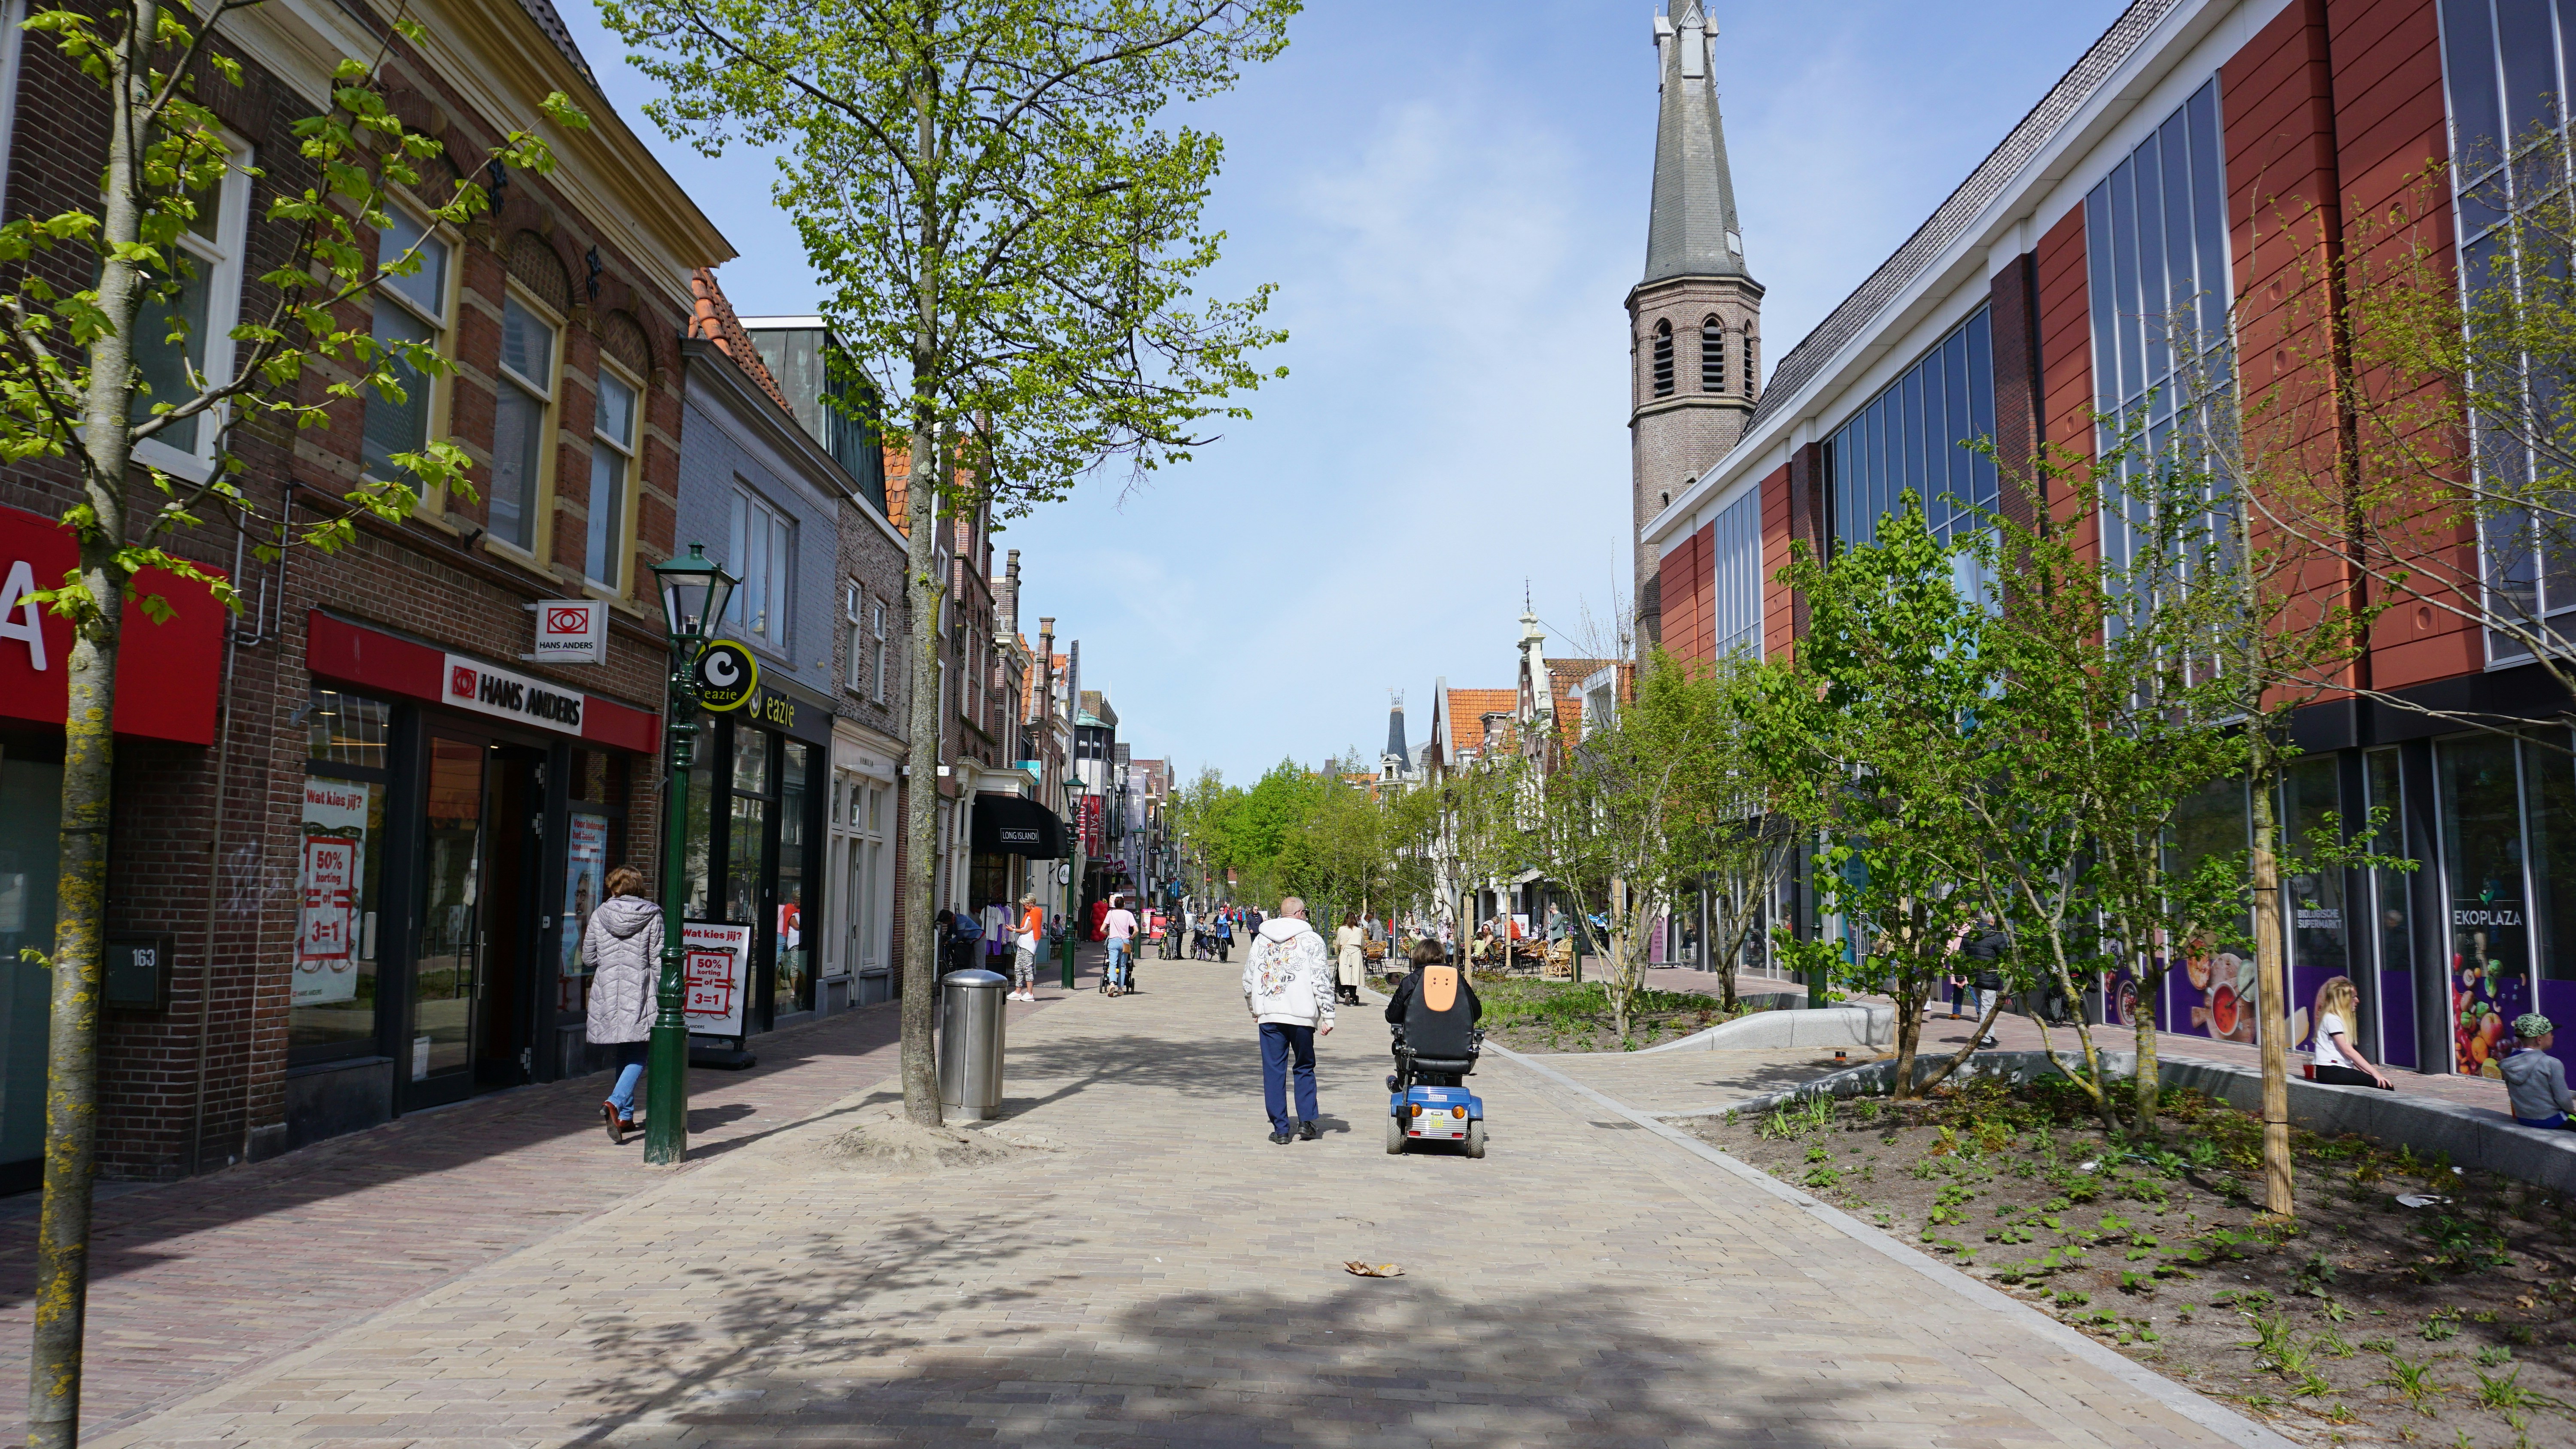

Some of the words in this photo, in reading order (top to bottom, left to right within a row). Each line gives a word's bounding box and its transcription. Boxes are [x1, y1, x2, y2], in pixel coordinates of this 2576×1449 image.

[480, 673, 523, 711] HANS
[526, 688, 580, 726] ANDERS
[705, 688, 737, 700] eazie
[767, 694, 794, 728] eazie
[860, 756, 873, 768] VANILIA
[307, 789, 325, 804] Wat
[326, 791, 345, 806] kies
[346, 794, 362, 810] jij?
[1090, 813, 1098, 838] SALE
[316, 851, 343, 870] 50%
[316, 872, 341, 885] korting
[322, 890, 332, 903] of
[2297, 909, 2339, 918] BIOLOGISCHE
[2454, 910, 2522, 925] EKOPLAZA
[2298, 919, 2342, 928] SUPERMARKT
[312, 920, 338, 942] 3=1
[683, 929, 701, 937] Wat
[704, 929, 725, 939] kies
[726, 931, 742, 941] jij?
[132, 949, 155, 967] 163
[697, 958, 722, 969] 50%
[694, 993, 719, 1005] 3=1
